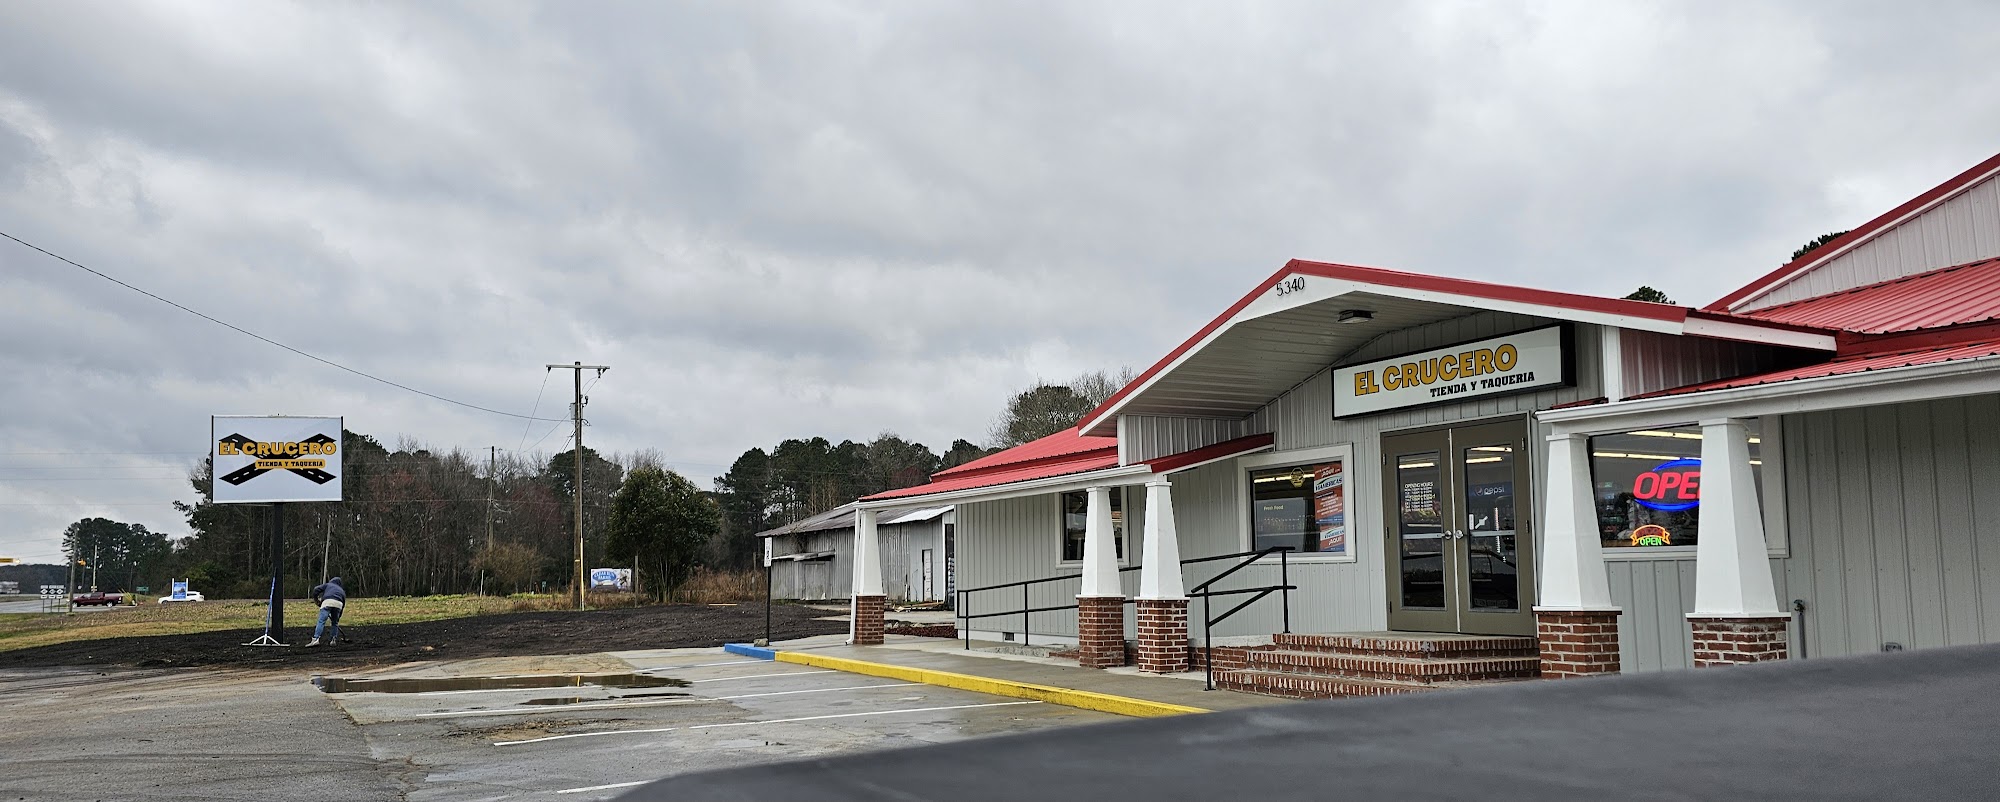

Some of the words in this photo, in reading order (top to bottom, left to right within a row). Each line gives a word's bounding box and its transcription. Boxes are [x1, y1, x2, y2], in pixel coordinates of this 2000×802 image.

[1276, 276, 1305, 297] 5340
[1354, 369, 1380, 397] EL
[1382, 343, 1518, 392] CRUCERO
[1430, 382, 1467, 398] TIENDA
[1470, 380, 1478, 391] Y
[1480, 371, 1535, 390] TAQUERIA
[218, 441, 239, 456] EL
[241, 441, 337, 456] CRUCERO
[1483, 485, 1505, 496] pepsi
[1632, 471, 1702, 500] OPE
[1639, 536, 1663, 547] OPEN
